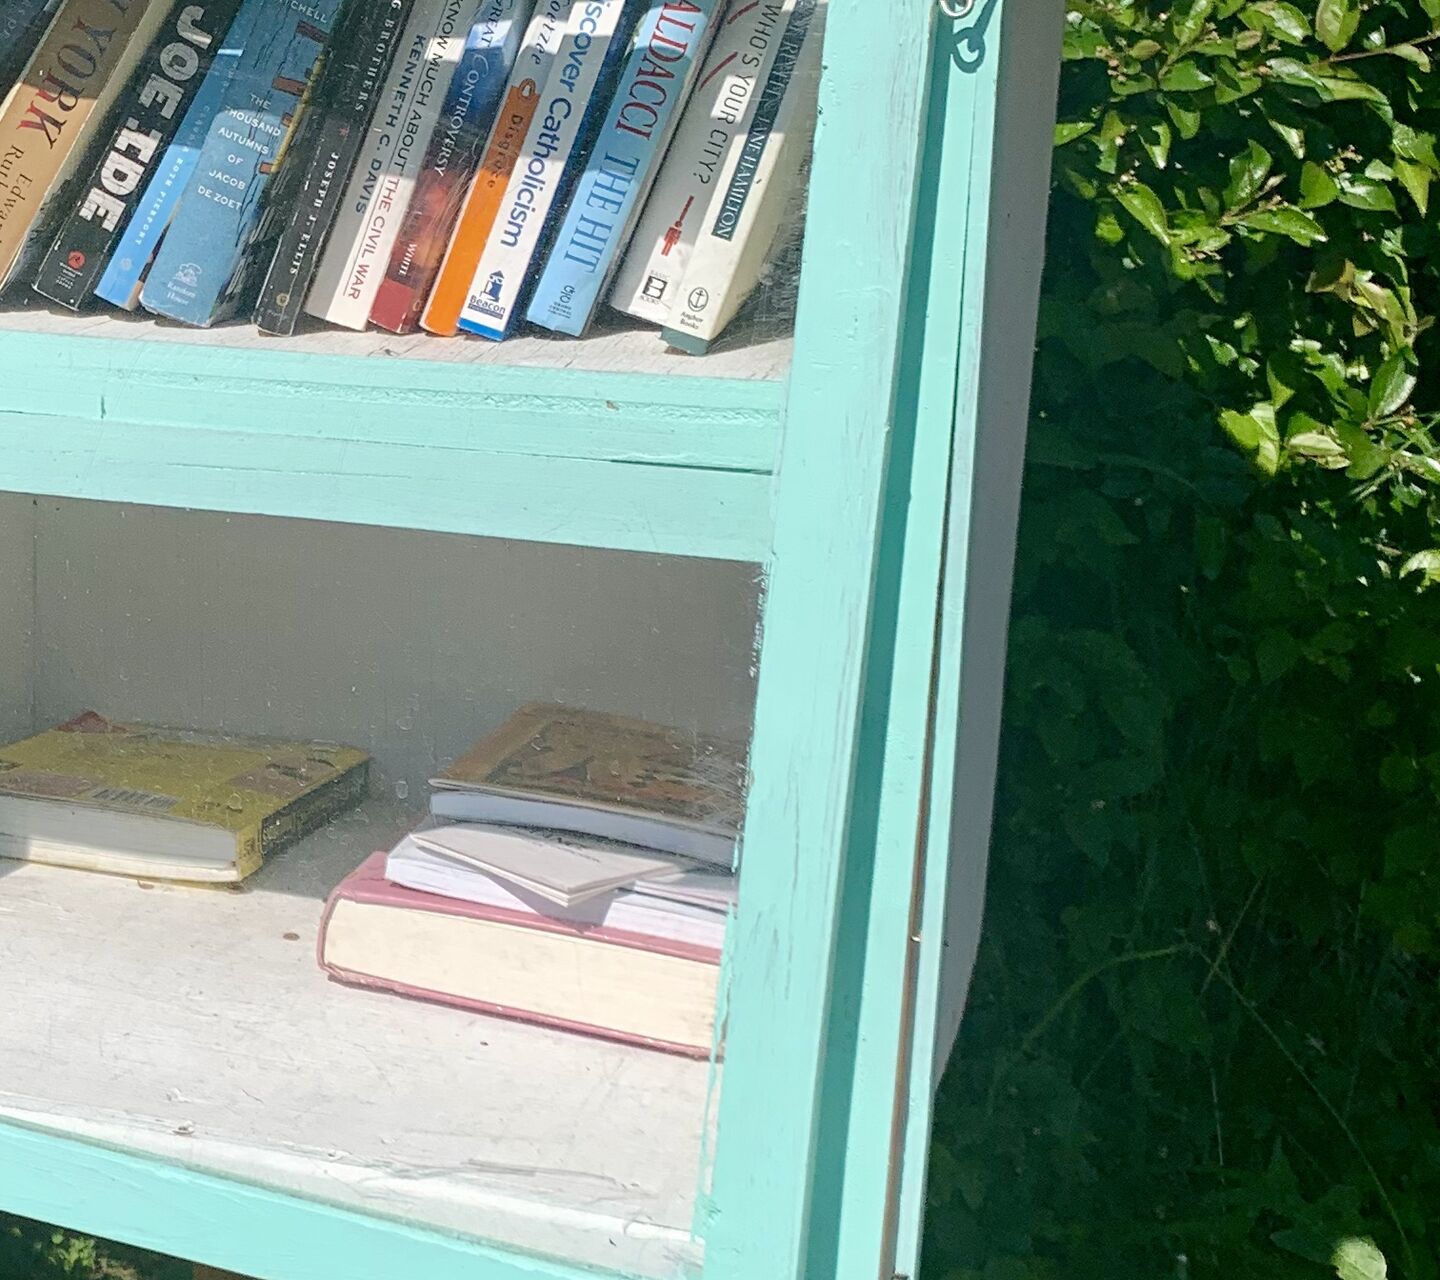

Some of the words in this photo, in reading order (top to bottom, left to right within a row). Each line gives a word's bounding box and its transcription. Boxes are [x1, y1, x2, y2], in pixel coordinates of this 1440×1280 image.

[138, 5, 213, 120] JOE
[738, 0, 781, 70] WHO'S
[16, 16, 116, 150] YORK
[351, 17, 396, 113] BROTHERS
[383, 33, 429, 129] KENNETH
[413, 53, 445, 107] MUCH
[225, 105, 282, 138] THOUSAND
[249, 93, 272, 111] THE
[431, 52, 491, 180] CONTROVERSY
[715, 70, 753, 127] YOUR
[217, 126, 270, 156] AUTUMNS
[226, 153, 244, 167] OF
[375, 132, 393, 155] C.
[488, 114, 524, 189] Disgrace
[690, 126, 729, 186] CITY?
[744, 114, 771, 154] JANE
[163, 155, 184, 188] ROTH
[197, 185, 213, 200] DE
[213, 189, 243, 212] ZOET
[208, 169, 247, 191] JACOB
[310, 150, 340, 209] JOSEPH
[352, 157, 384, 215] DAVIS
[377, 175, 402, 213] THE
[500, 95, 573, 249] Catholicism
[586, 151, 642, 216] THE
[714, 152, 759, 240] HAMILTON
[132, 188, 167, 248] PIERPONT
[359, 214, 388, 261] CIVIL
[564, 213, 613, 275] HIT
[287, 232, 312, 277] ELLIS
[346, 261, 372, 301] WAR
[469, 294, 506, 314] Beacon
